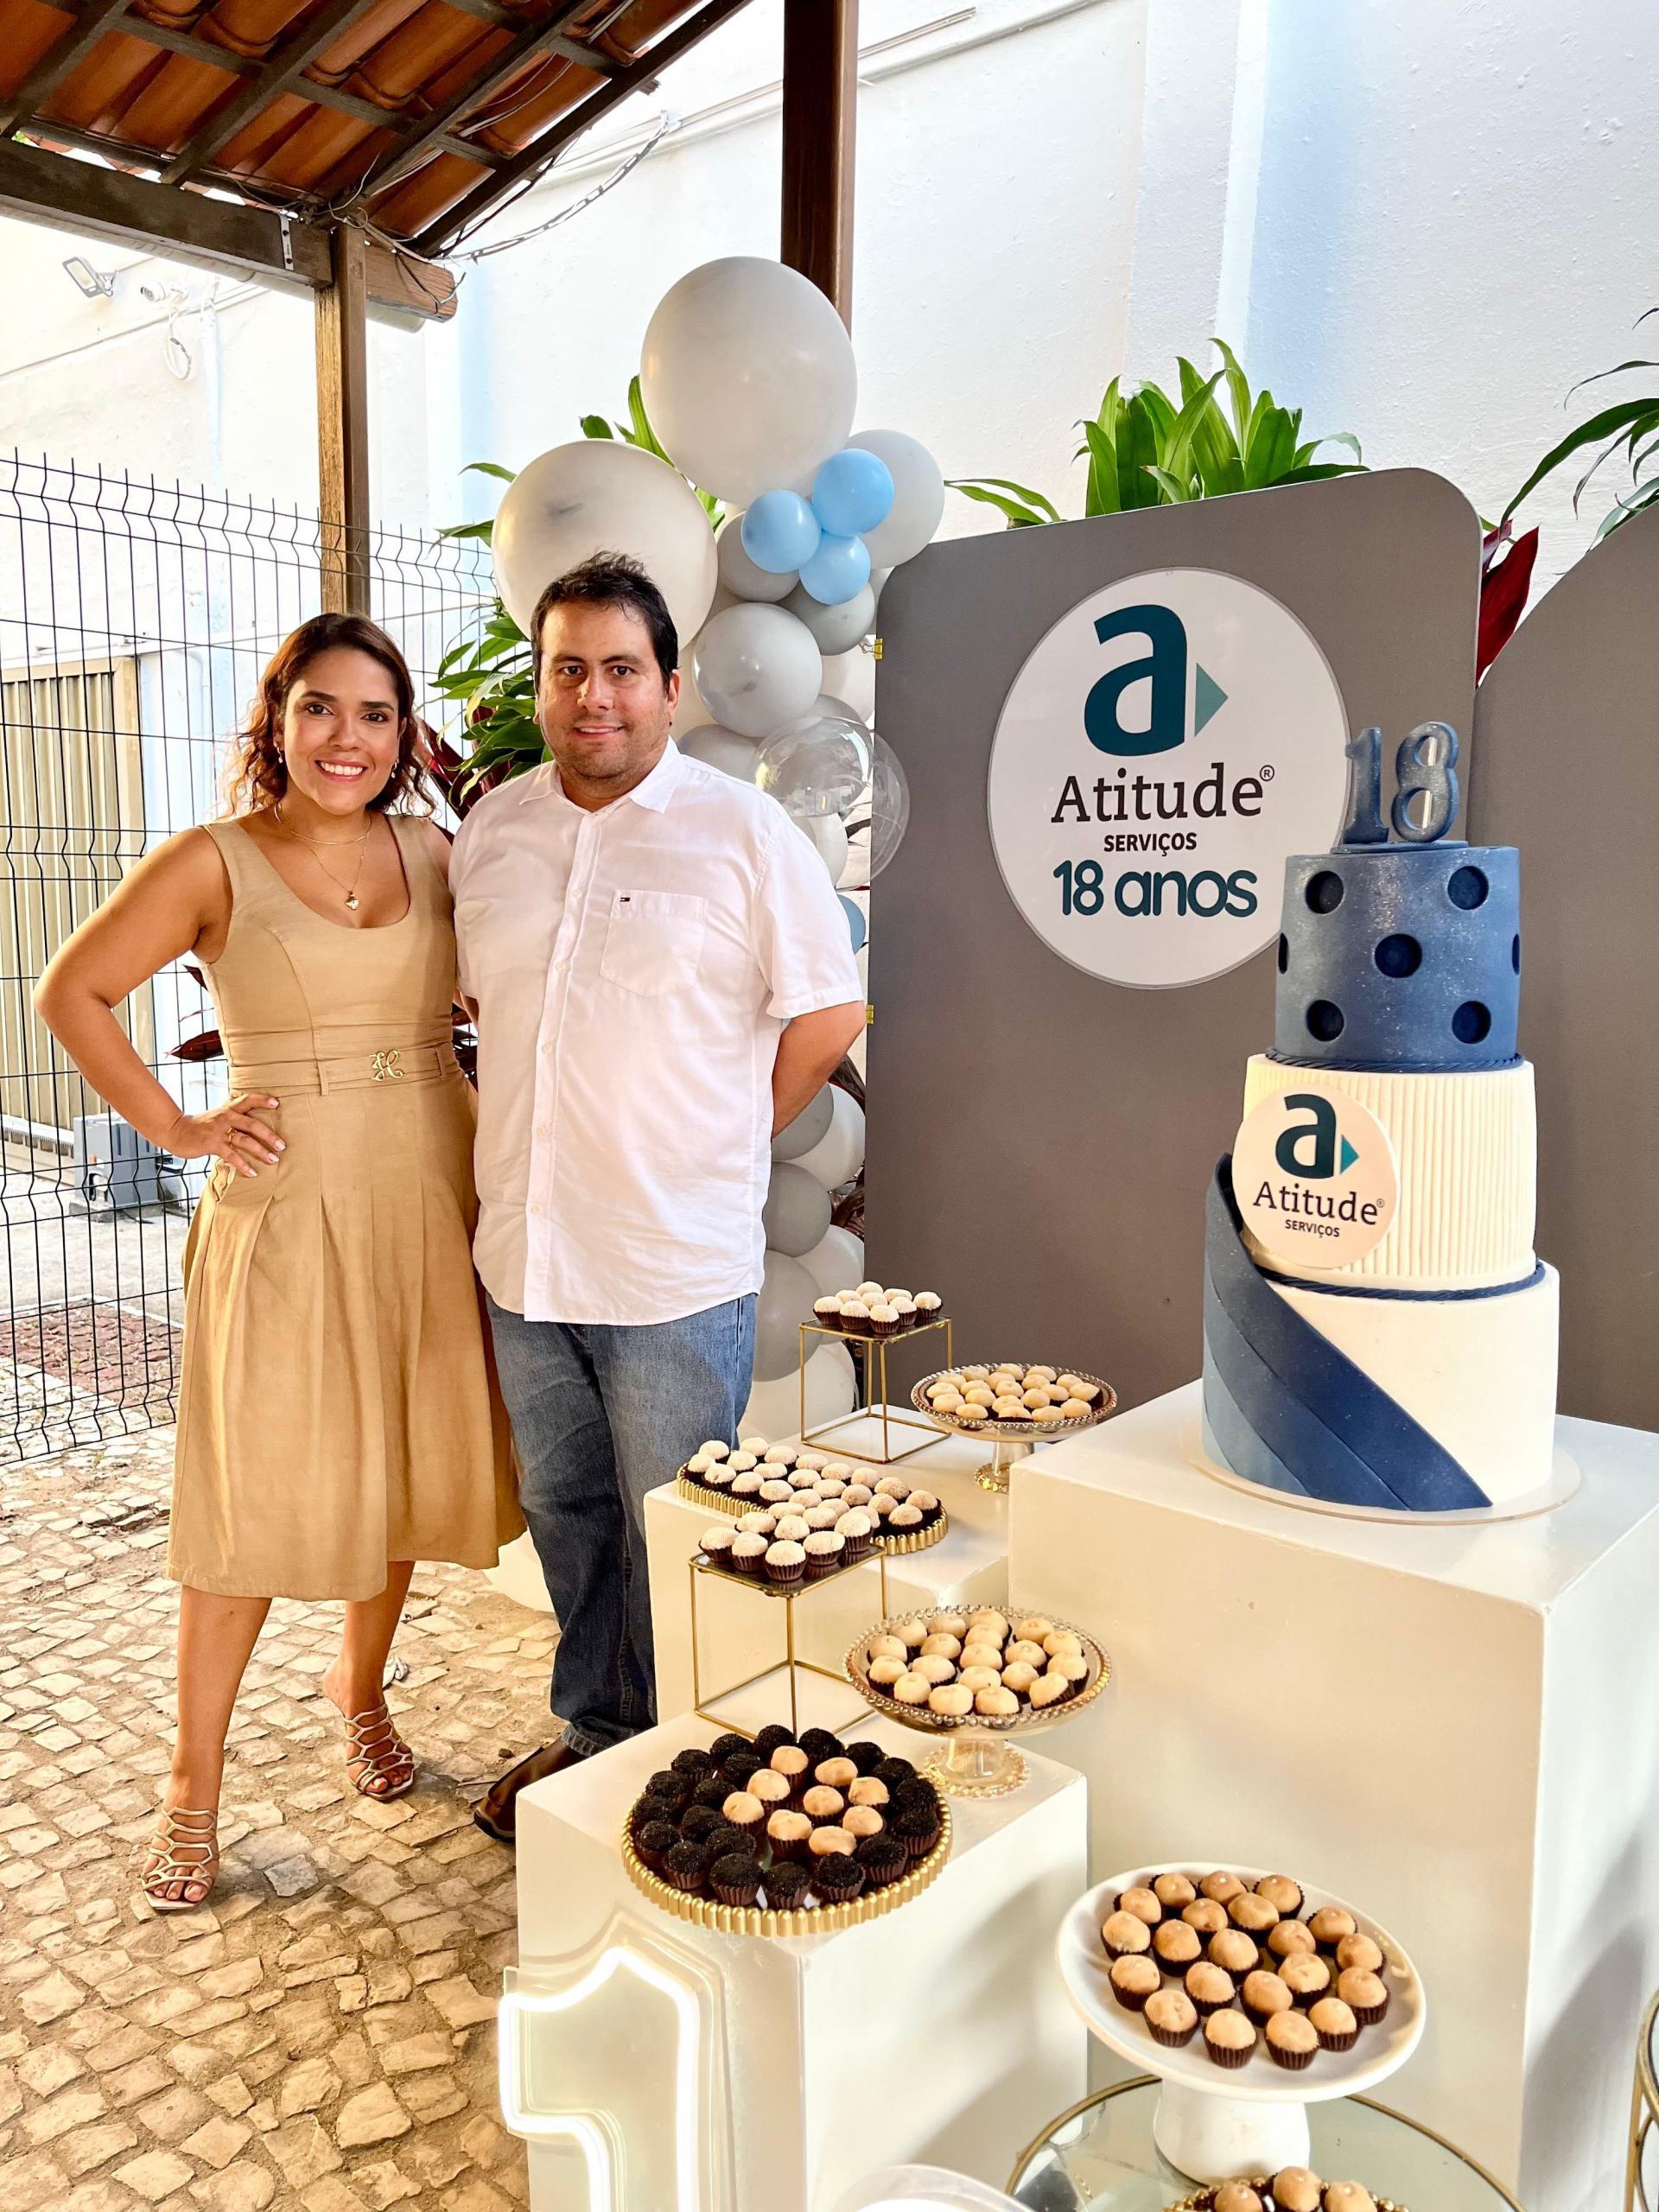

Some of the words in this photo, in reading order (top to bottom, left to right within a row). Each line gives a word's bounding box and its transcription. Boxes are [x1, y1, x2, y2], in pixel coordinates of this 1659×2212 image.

[1341, 721, 1460, 844] 18
[1103, 832, 1198, 857] SERVIÇOS
[1052, 859, 1104, 917] 18
[1114, 868, 1258, 918] anos
[1284, 1219, 1340, 1238] SERVIÇOS
